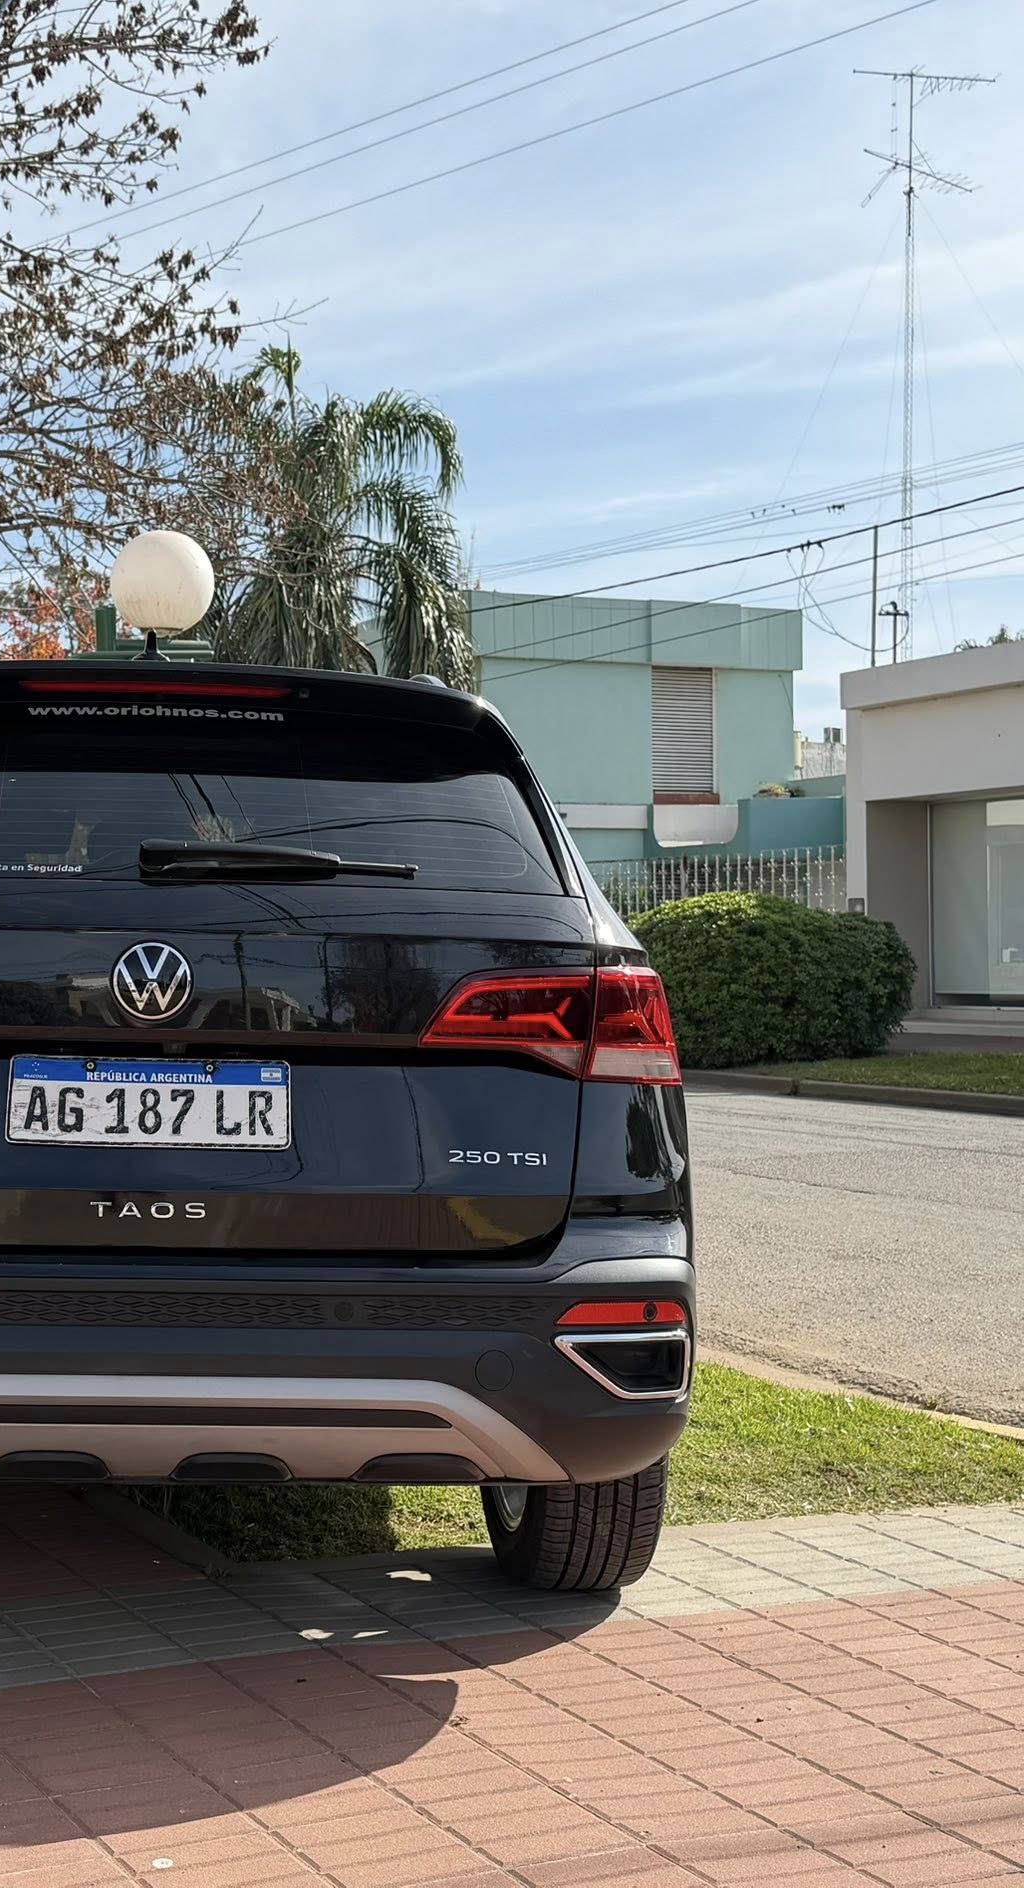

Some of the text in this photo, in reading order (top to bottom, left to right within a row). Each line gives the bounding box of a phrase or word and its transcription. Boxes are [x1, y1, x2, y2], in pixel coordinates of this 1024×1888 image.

[27, 705, 285, 722] www.oriohnos.com
[11, 864, 25, 872] en
[27, 863, 84, 874] Seguridad
[114, 944, 191, 1018] VW
[86, 1070, 213, 1084] REPÚBLICA ARGENTINA
[23, 1086, 274, 1137] AG 187 LR
[448, 1149, 547, 1166] 250 TSI
[89, 1201, 207, 1219] TAOS
